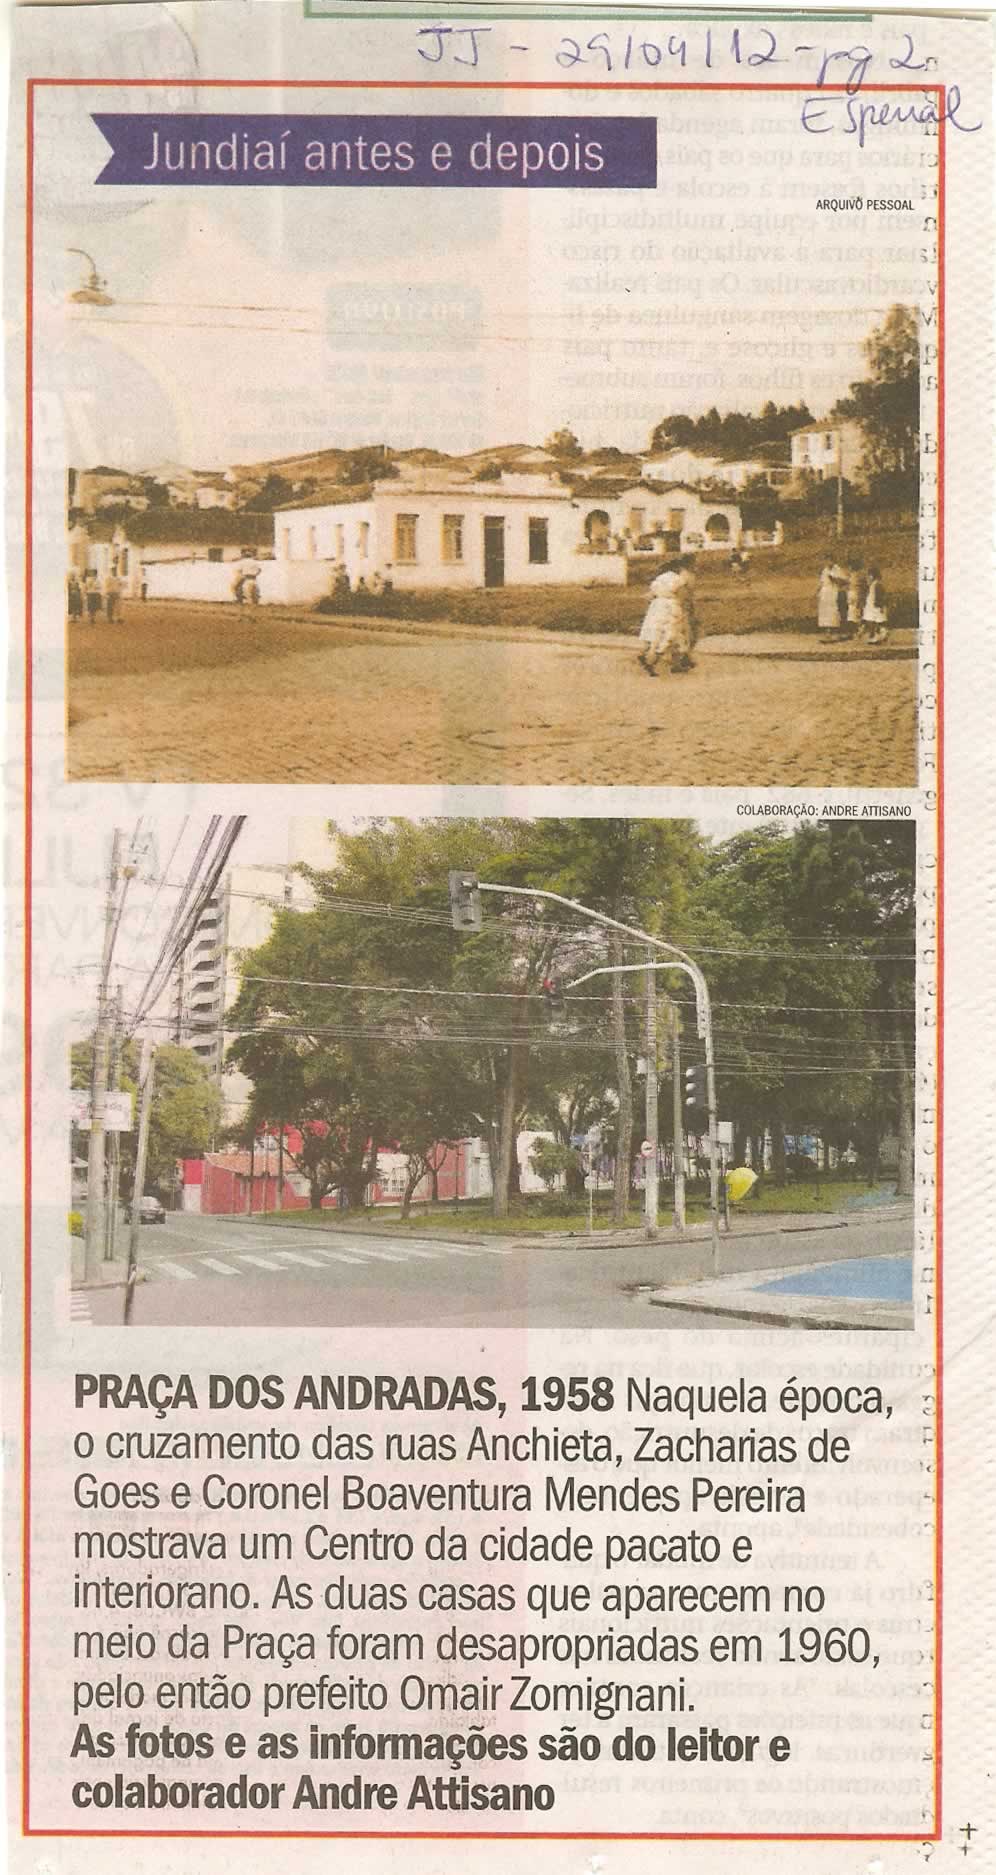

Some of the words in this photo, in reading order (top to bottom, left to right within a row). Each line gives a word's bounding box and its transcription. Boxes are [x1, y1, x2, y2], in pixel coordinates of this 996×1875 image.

[143, 130, 291, 171] Jundiaí
[304, 136, 415, 171] antes
[431, 141, 452, 171] e
[469, 132, 604, 179] depois
[815, 198, 863, 212] ARQUIVO
[866, 199, 914, 211] PESSOAL
[736, 803, 819, 818] COLABORAÇÃO:
[822, 805, 858, 816] ANDRE
[861, 805, 912, 817] ATTISANO
[75, 1373, 199, 1420] PRAÇA
[209, 1374, 285, 1410] DOS
[293, 1375, 507, 1419] ANDRADAS,
[521, 1375, 615, 1412] 1958
[627, 1377, 767, 1421] Naquela
[779, 1375, 893, 1421] época,
[74, 1431, 95, 1459] o
[105, 1427, 300, 1460] cruzamento
[312, 1425, 374, 1461] das
[386, 1433, 457, 1461] ruas
[466, 1426, 623, 1468] Anchieta,
[633, 1427, 798, 1463] Zacharias
[808, 1428, 851, 1464] de
[74, 1472, 161, 1510] Goes
[171, 1482, 191, 1510] e
[202, 1473, 329, 1510] Coronel
[343, 1475, 532, 1512] Boaventura
[545, 1476, 681, 1513] Mendes
[692, 1477, 806, 1513] Pereira
[74, 1526, 227, 1560] mostrava
[240, 1532, 292, 1560] um
[305, 1524, 414, 1561] Centro
[425, 1525, 467, 1561] da
[480, 1526, 593, 1562] cidade
[605, 1530, 721, 1570] pacato
[732, 1535, 753, 1563] e
[74, 1573, 259, 1610] interiorano.
[271, 1574, 314, 1610] As
[324, 1575, 408, 1611] duas
[418, 1583, 516, 1611] casas
[527, 1584, 591, 1620] que
[602, 1584, 771, 1620] aparecem
[784, 1585, 826, 1613] no
[74, 1623, 156, 1659] meio
[167, 1623, 209, 1660] da
[223, 1624, 315, 1669] Praça
[326, 1624, 424, 1661] foram
[436, 1625, 699, 1669] desapropriadas
[709, 1635, 762, 1663] em
[778, 1626, 880, 1669] 1960,
[73, 1673, 145, 1716] pelo
[156, 1673, 251, 1710] então
[264, 1674, 388, 1718] prefeito
[400, 1674, 504, 1711] Omair
[509, 1675, 695, 1721] Zomignani.
[69, 1723, 116, 1758] As
[125, 1722, 215, 1759] fotos
[224, 1732, 246, 1759] e
[257, 1732, 299, 1760] as
[310, 1723, 528, 1771] informações
[538, 1725, 601, 1761] são
[612, 1726, 656, 1762] do
[667, 1726, 760, 1762] leitor
[769, 1735, 791, 1762] e
[71, 1773, 286, 1809] colaborador
[292, 1774, 398, 1810] Andre
[406, 1775, 555, 1811] Attisano
